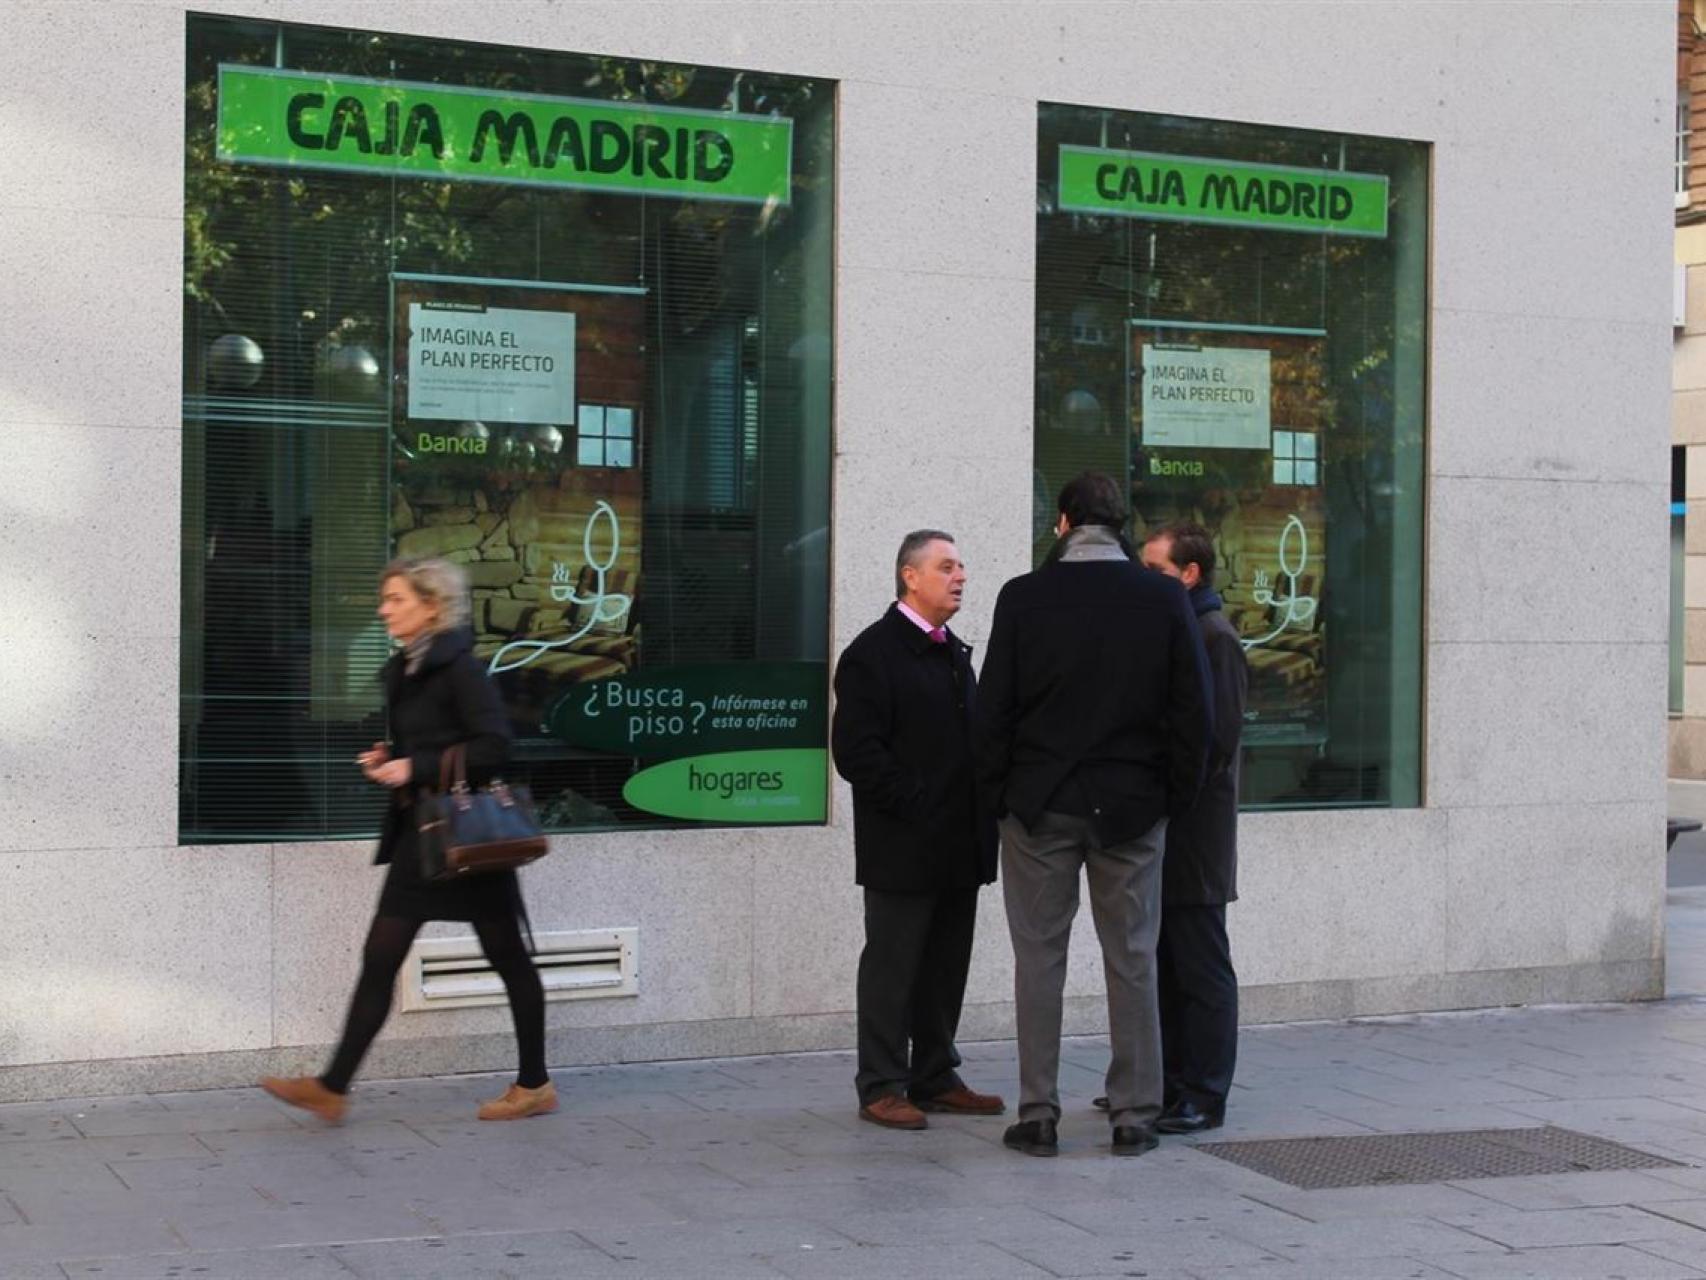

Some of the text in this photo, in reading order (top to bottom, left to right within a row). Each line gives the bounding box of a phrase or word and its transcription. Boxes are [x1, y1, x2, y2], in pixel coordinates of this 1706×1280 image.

[286, 92, 734, 184] CAJA MADRID
[1095, 163, 1354, 222] CAJA MADRID
[420, 327, 519, 348] IMAGINA EL
[420, 350, 555, 373] PLAN PERFECTO
[1151, 365, 1227, 383] IMAGINA EL
[1151, 385, 1255, 404] PLAN PERFECTO
[417, 432, 488, 454] Bankia
[1150, 457, 1204, 476] Bankia
[711, 694, 808, 713] Infórmese en
[711, 713, 798, 732] esta oficina
[688, 764, 784, 799] hogares
